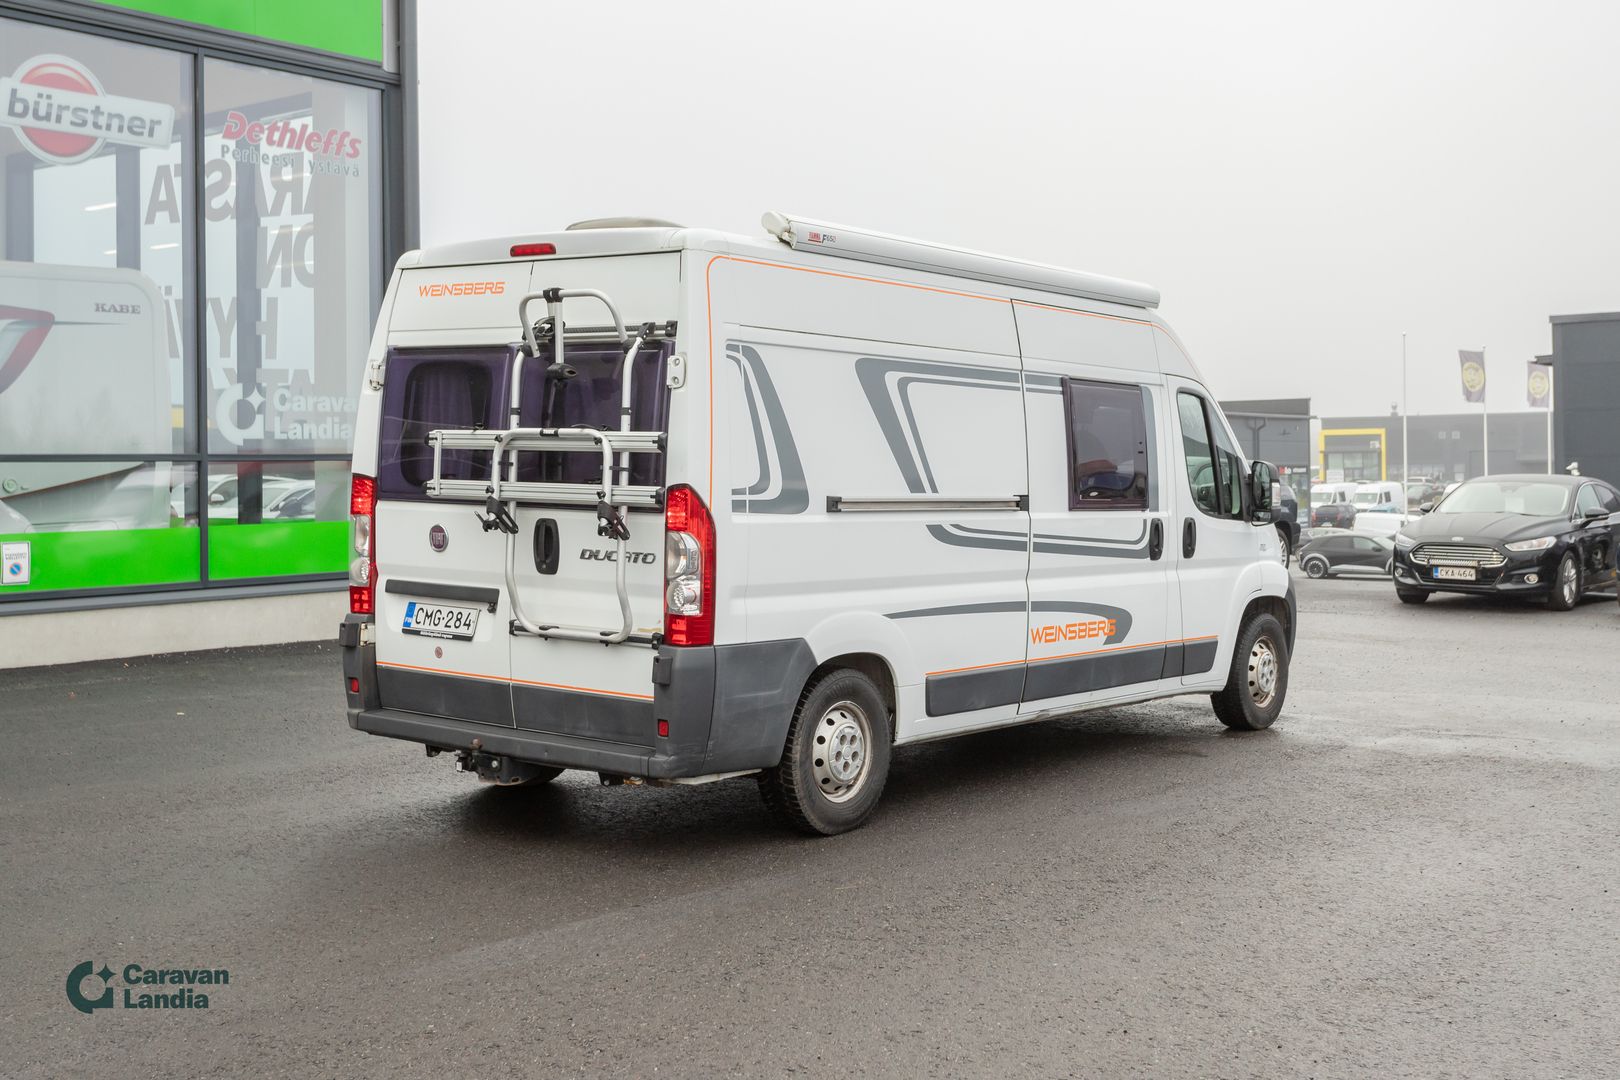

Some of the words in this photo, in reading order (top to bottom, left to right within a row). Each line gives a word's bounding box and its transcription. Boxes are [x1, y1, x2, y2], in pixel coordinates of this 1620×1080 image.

[7, 87, 162, 138] bürstner
[221, 111, 362, 159] Dethleffs
[220, 144, 295, 167] Perheesi
[418, 281, 505, 297] WEINSBERG
[94, 302, 141, 314] KABE
[273, 387, 359, 412] Carava
[274, 415, 354, 440] Landia
[415, 606, 472, 631] CMG-284
[1030, 618, 1117, 645] WEINSBERG
